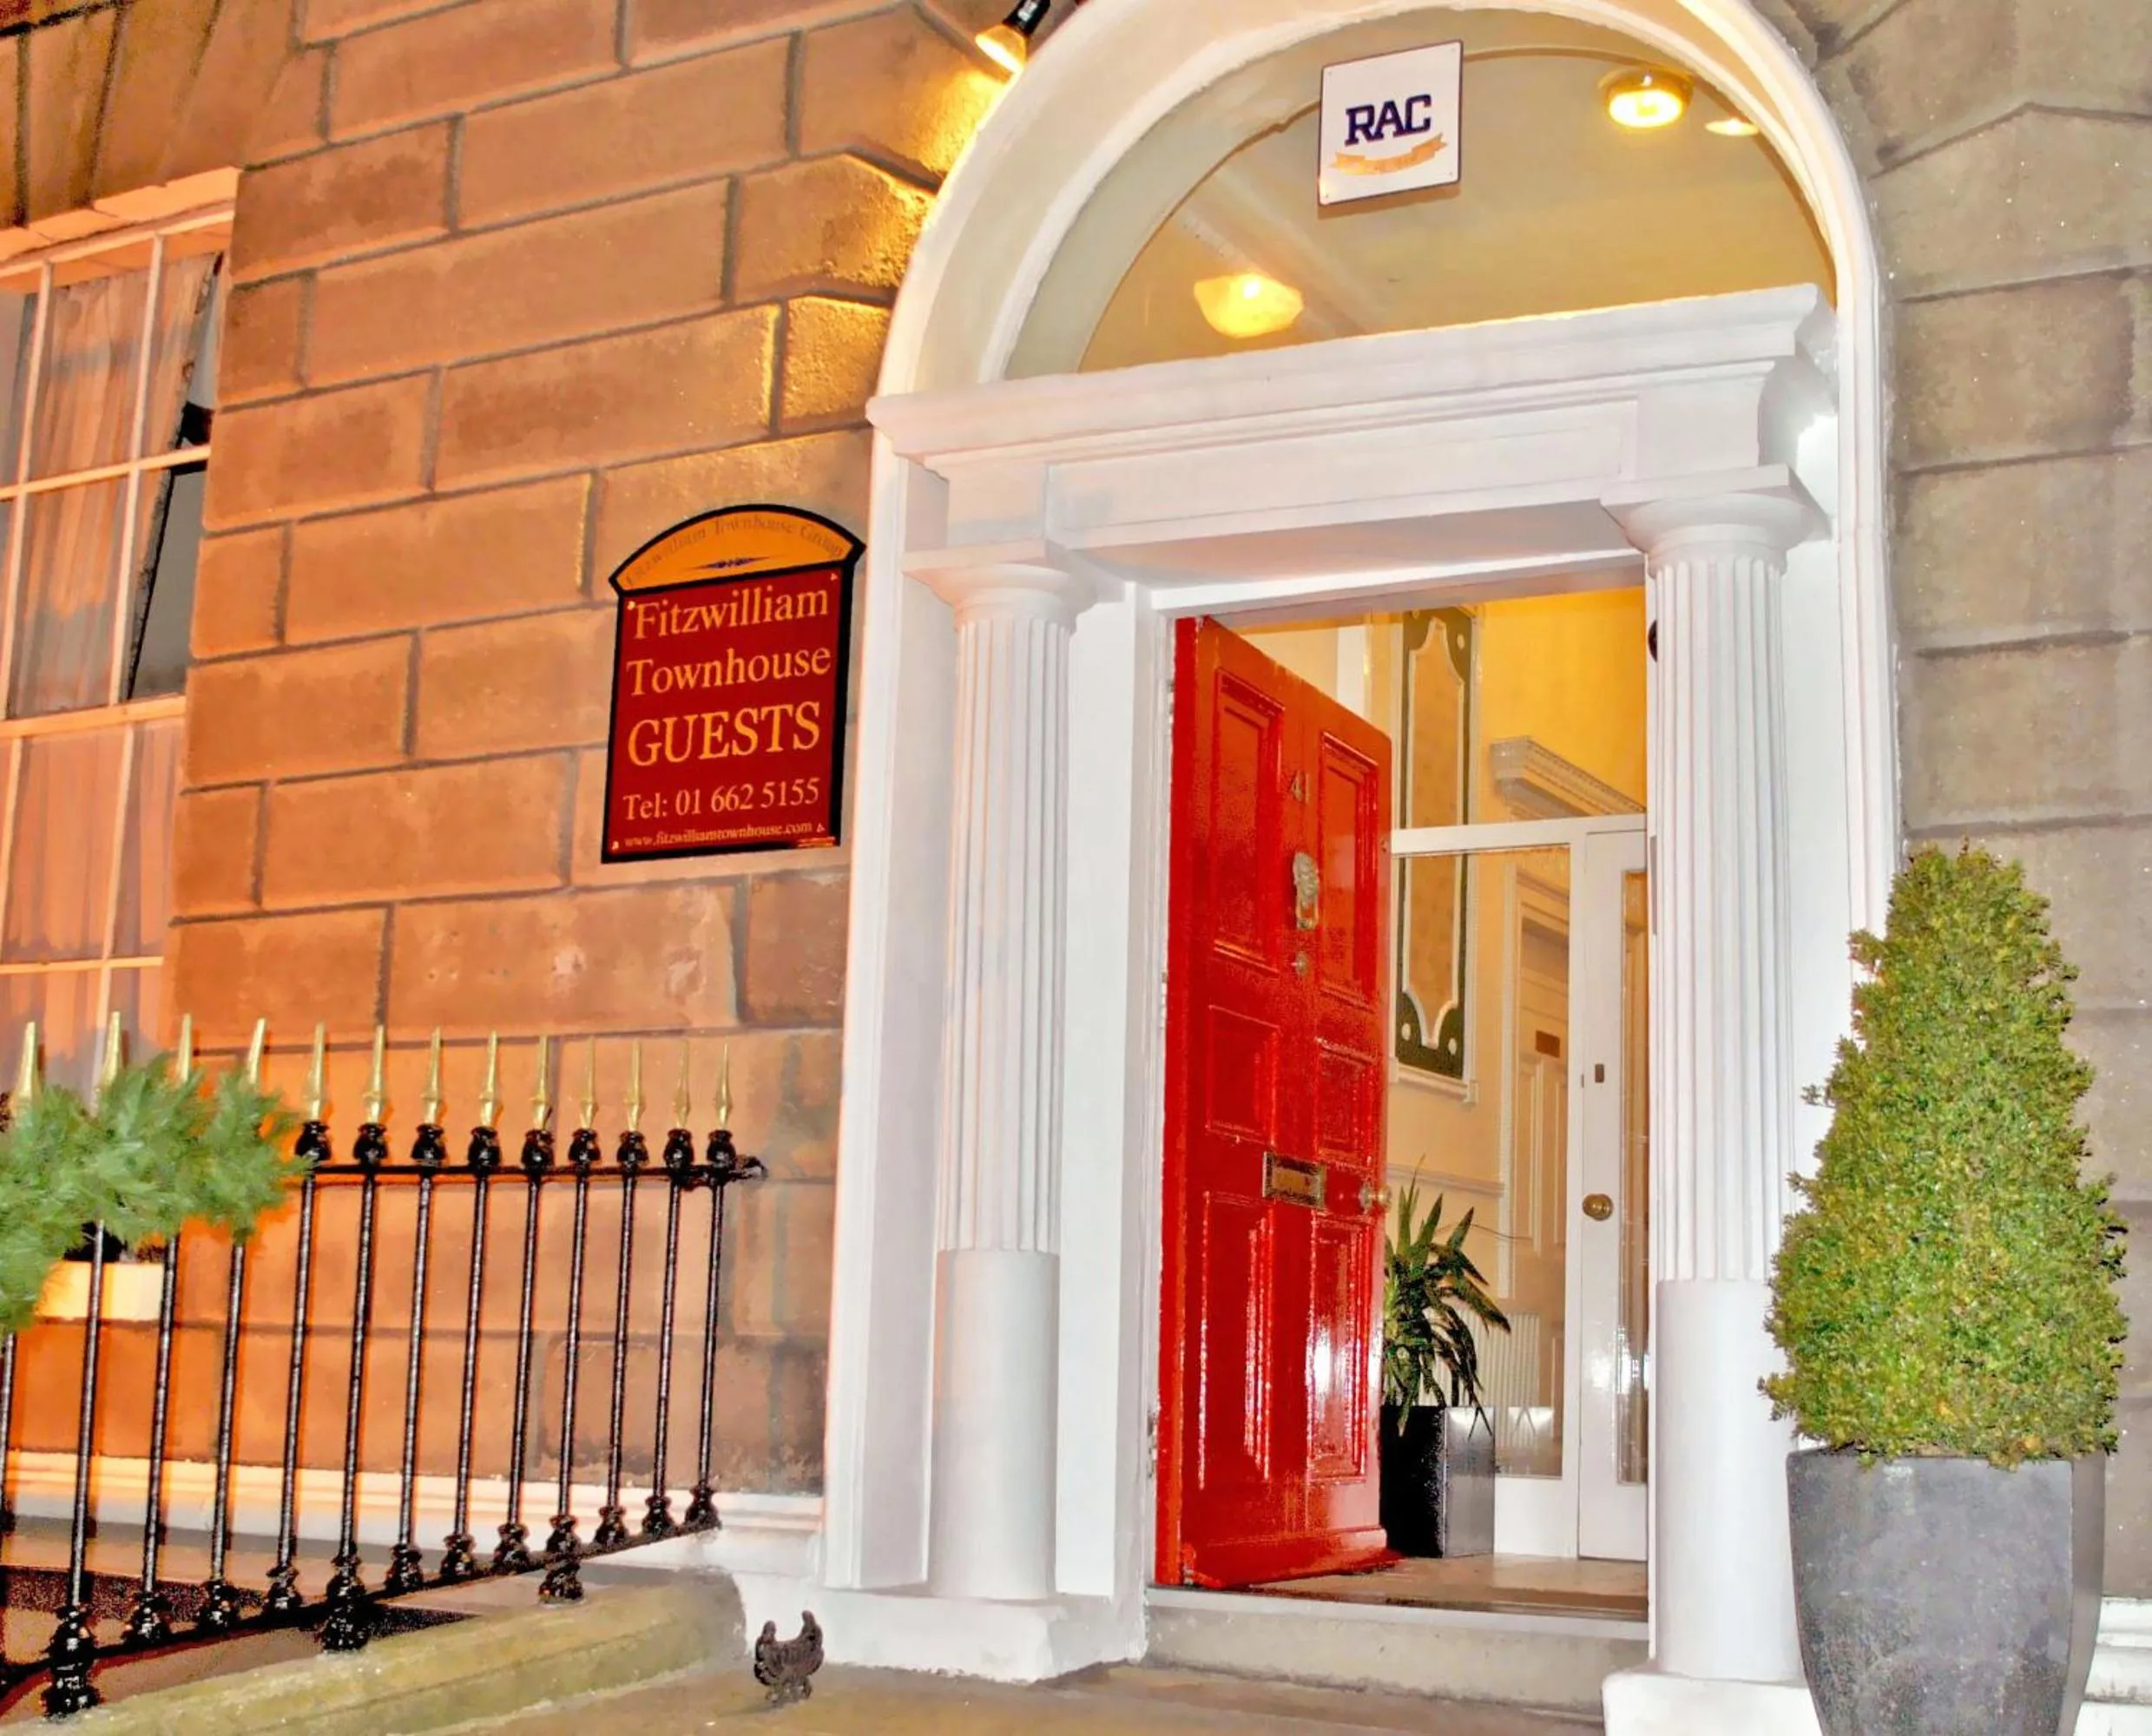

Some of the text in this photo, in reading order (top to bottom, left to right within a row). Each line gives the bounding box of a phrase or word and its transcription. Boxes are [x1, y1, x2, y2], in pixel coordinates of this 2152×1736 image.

[1345, 94, 1431, 147] RAC
[633, 584, 829, 640] Fitzwilliam
[626, 647, 832, 697] Townhouse
[628, 700, 821, 766] GUESTS
[622, 778, 820, 820] Tel: 01 662 5155
